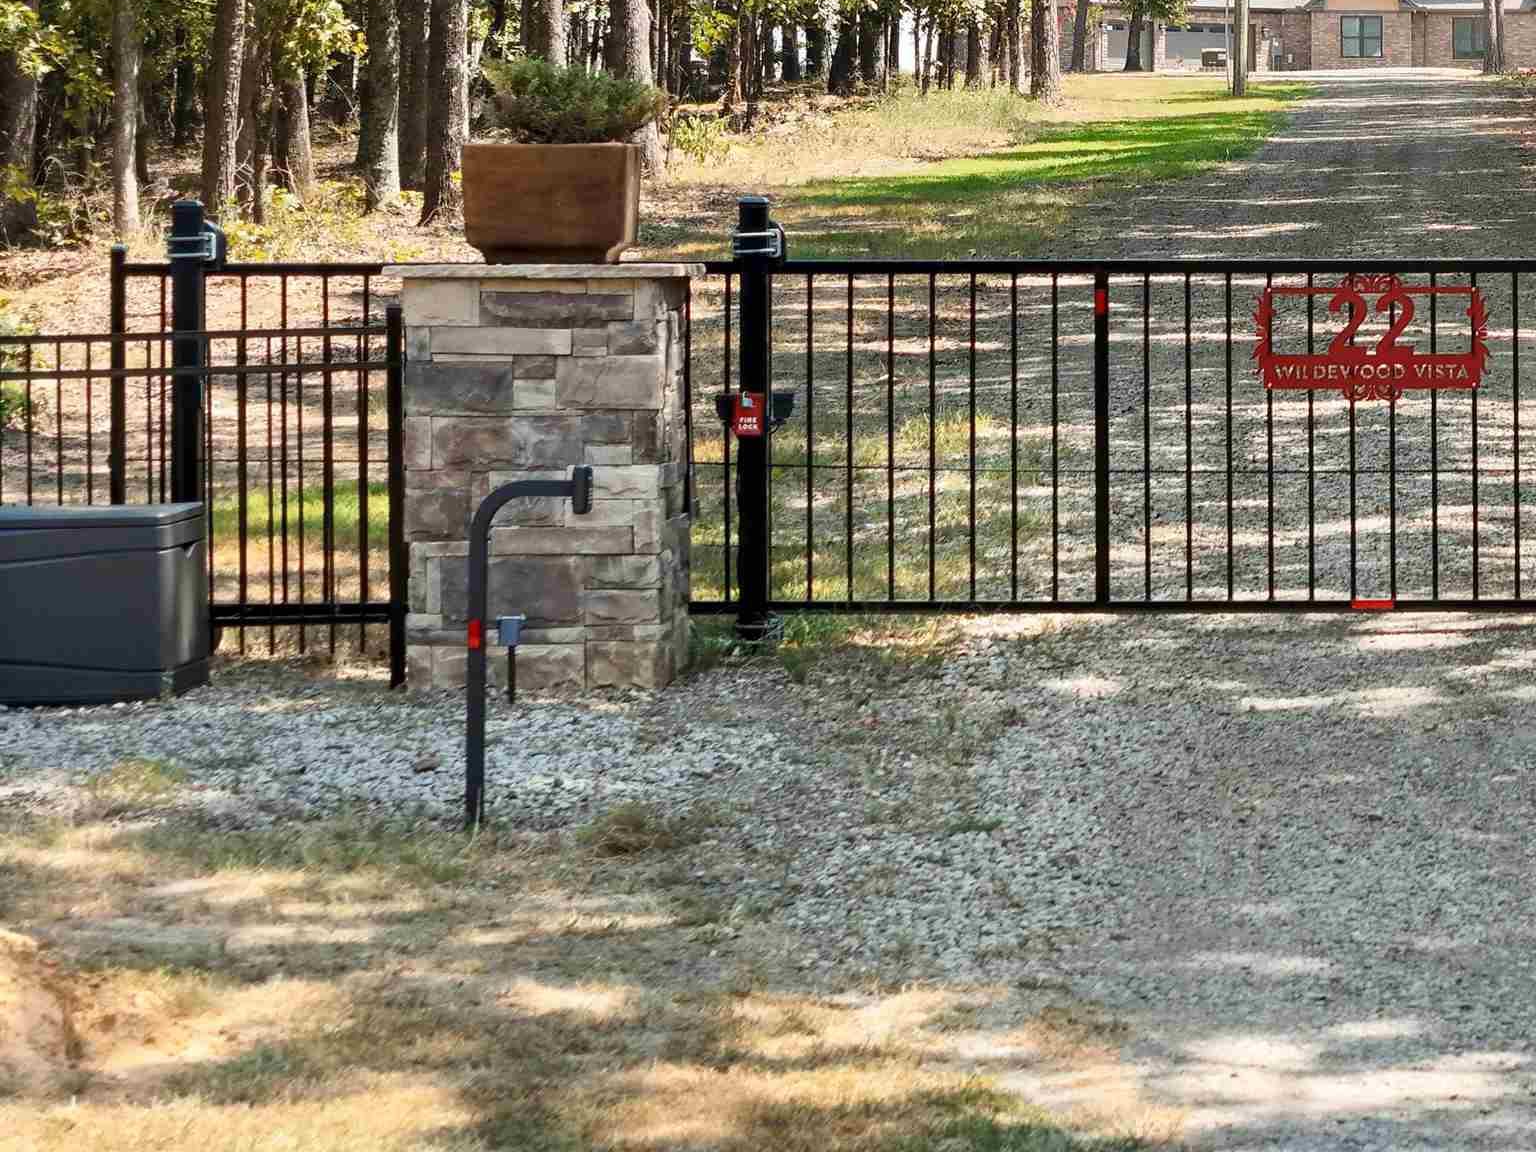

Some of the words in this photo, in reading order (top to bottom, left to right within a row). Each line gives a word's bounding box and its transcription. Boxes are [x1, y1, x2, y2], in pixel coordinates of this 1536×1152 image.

[1328, 289, 1415, 356] 22
[1274, 364, 1405, 380] WILDEWOOD
[1413, 364, 1469, 379] VISTA
[739, 416, 758, 424] FIRE
